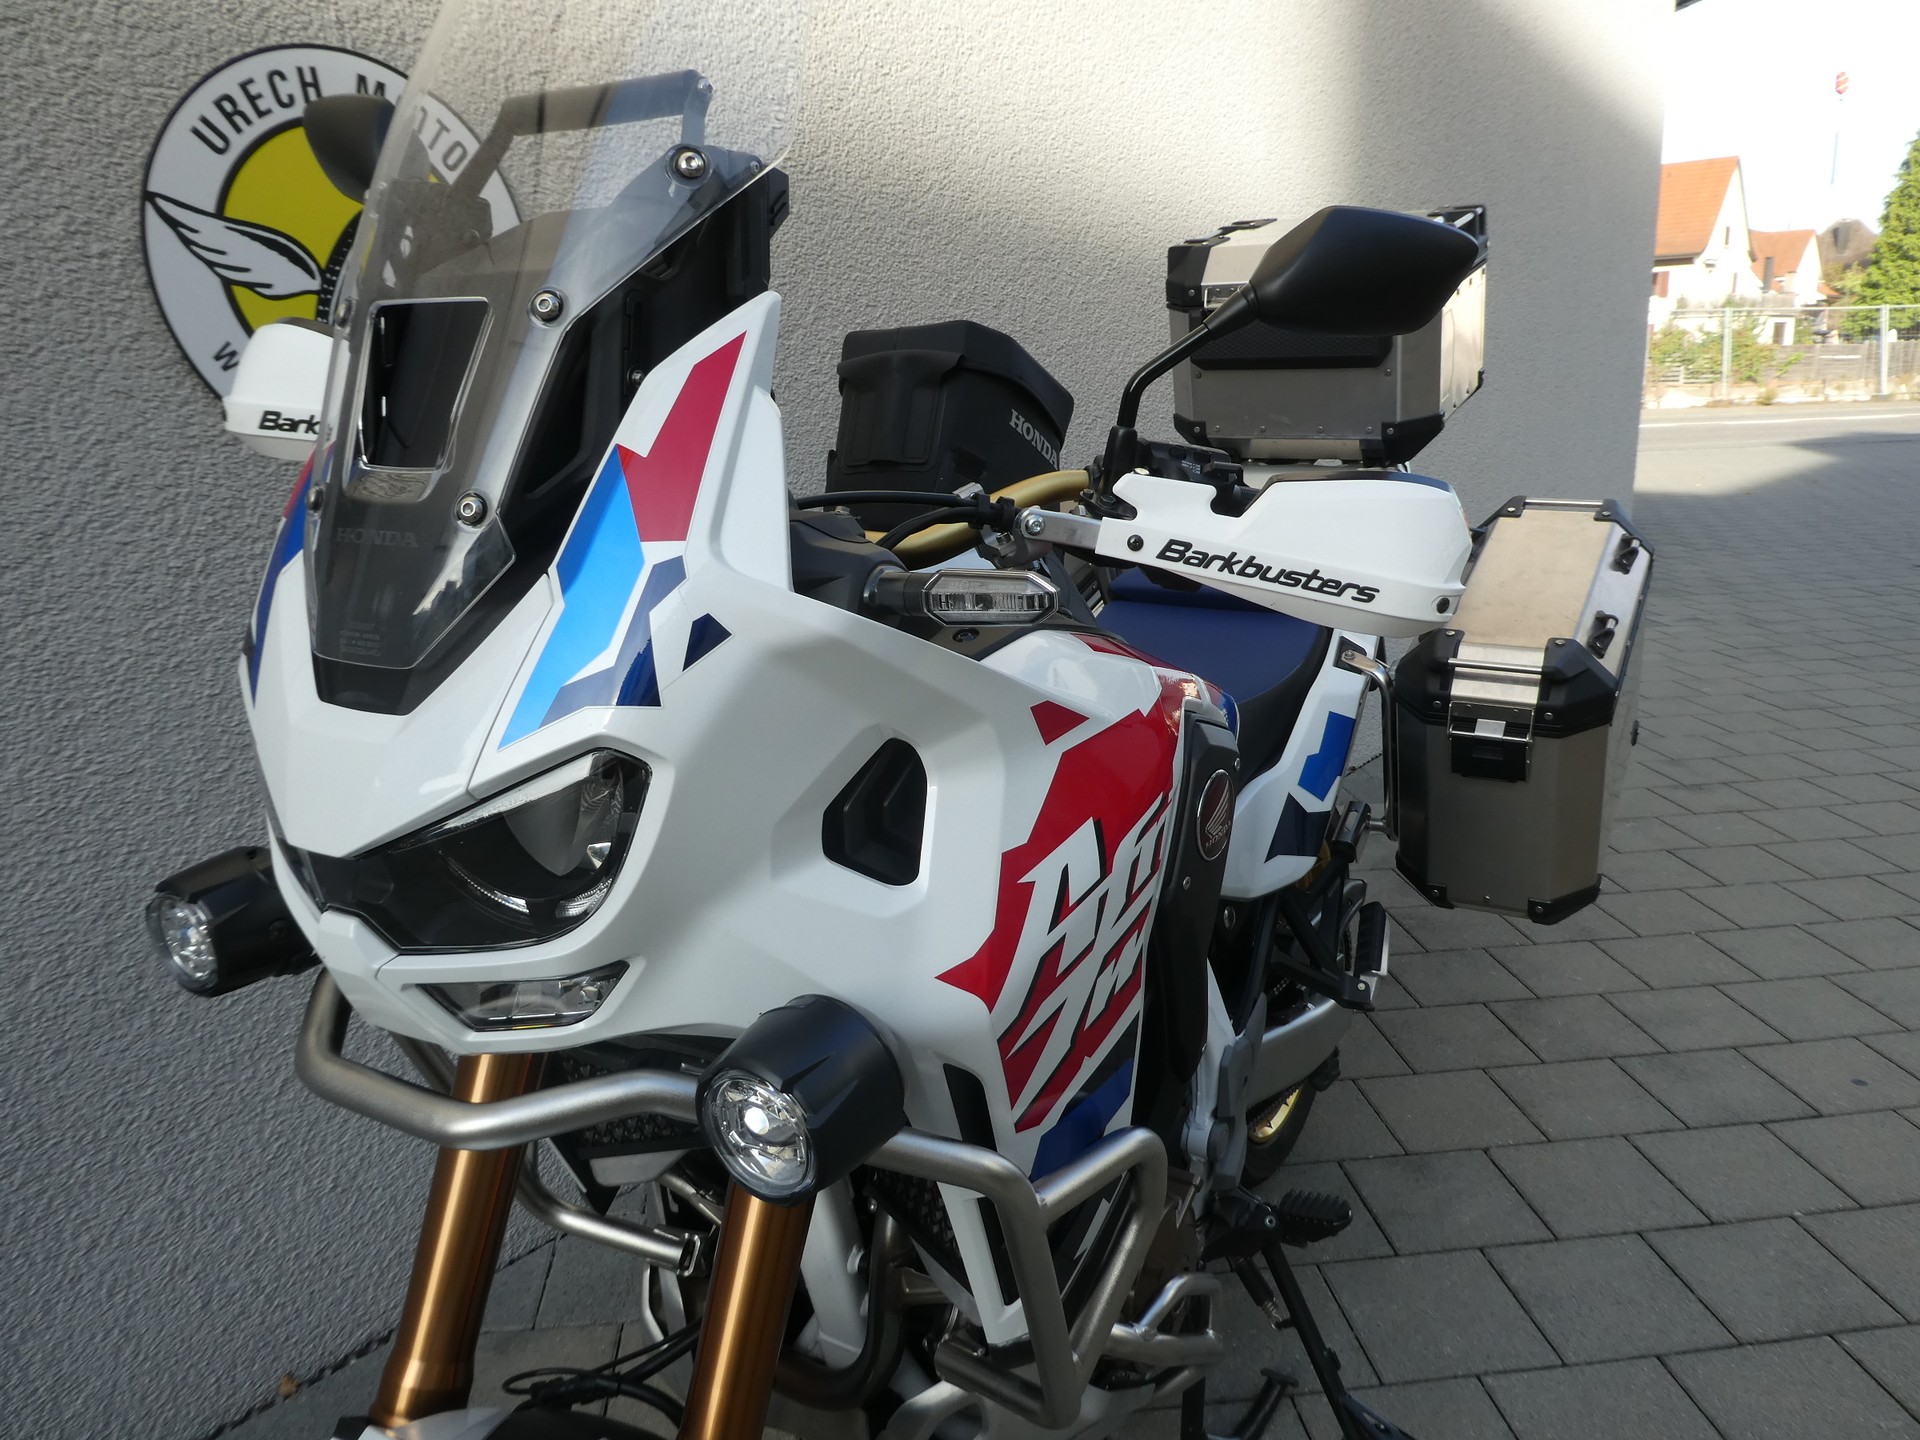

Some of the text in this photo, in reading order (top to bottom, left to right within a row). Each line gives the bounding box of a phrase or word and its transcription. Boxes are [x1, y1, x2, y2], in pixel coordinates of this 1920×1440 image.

[190, 65, 322, 155] URECH
[1009, 408, 1059, 471] HONDA
[335, 527, 418, 548] HONDA
[1155, 538, 1380, 603] Barkbusters
